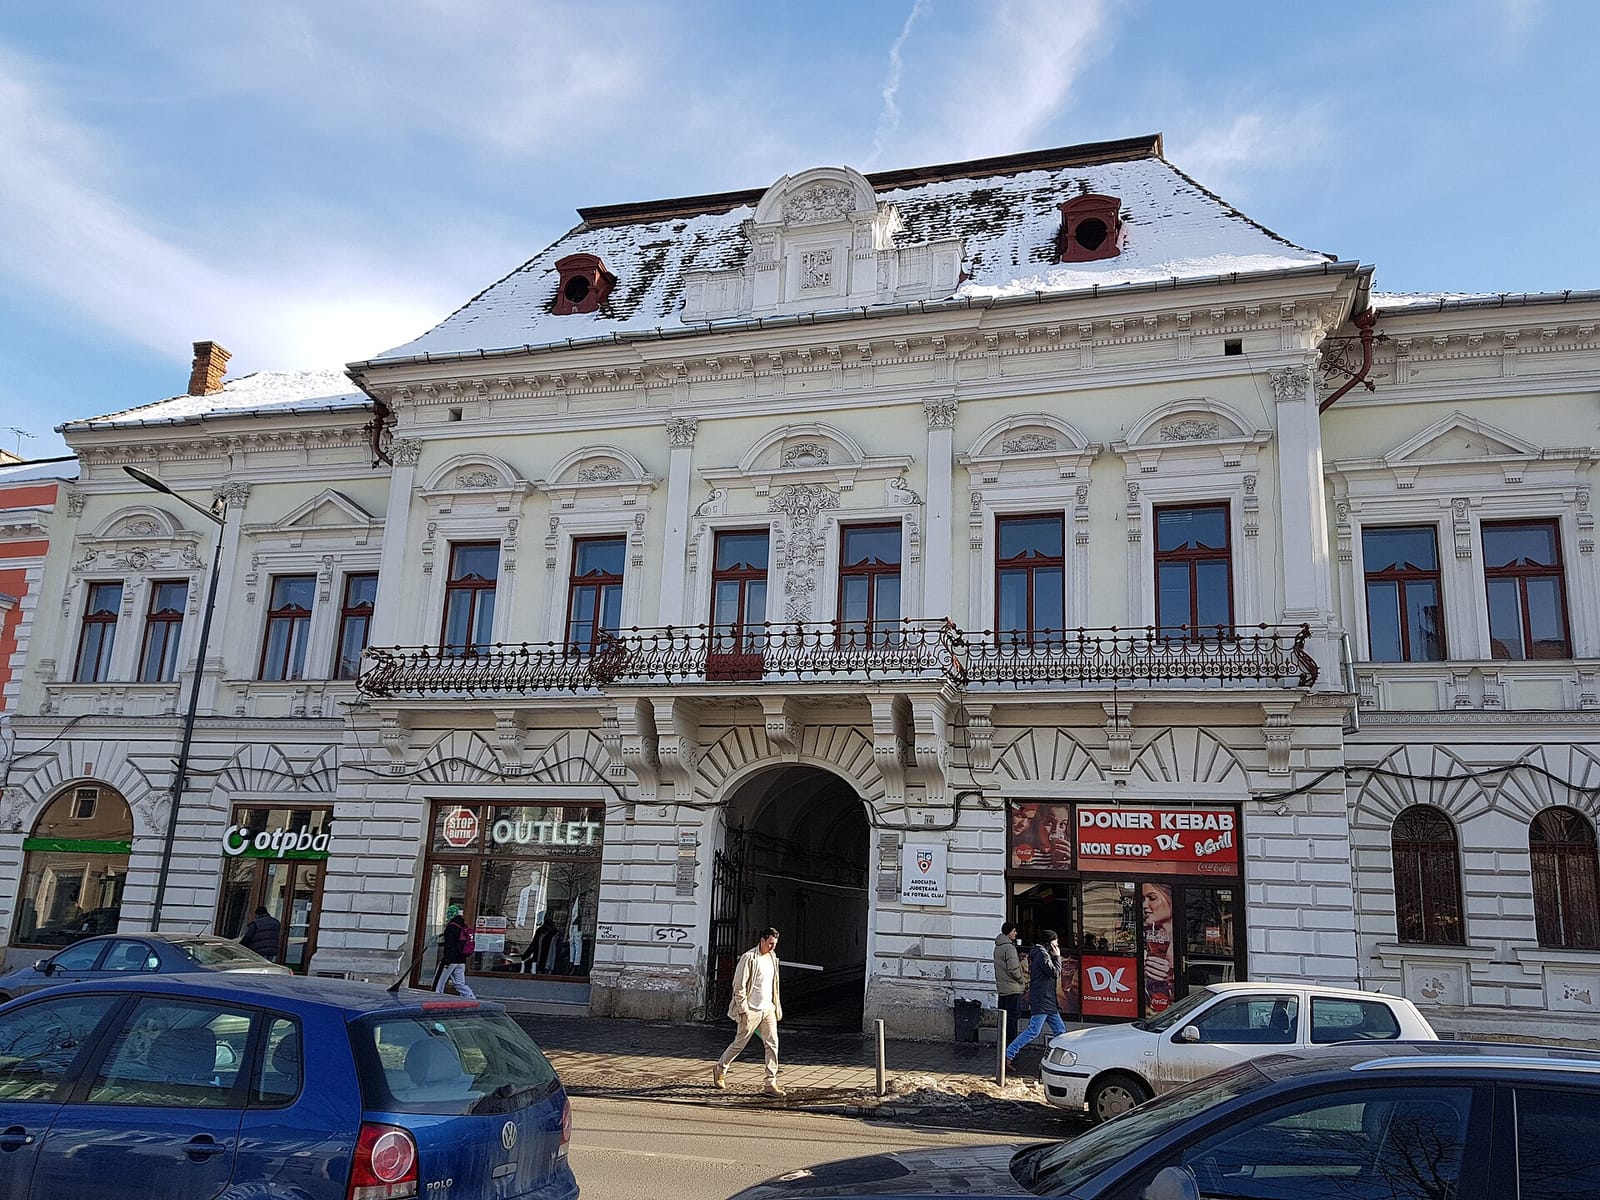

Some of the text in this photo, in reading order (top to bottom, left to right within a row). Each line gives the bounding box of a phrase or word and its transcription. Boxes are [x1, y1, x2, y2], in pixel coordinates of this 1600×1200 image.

[450, 817, 473, 829] STOP
[1079, 811, 1234, 830] DONER KEBAB
[492, 819, 600, 845] OUTLET
[1080, 842, 1152, 857] NON STOP
[1153, 833, 1185, 851] DK
[1085, 966, 1131, 994] DK
[426, 1178, 453, 1192] POLO
